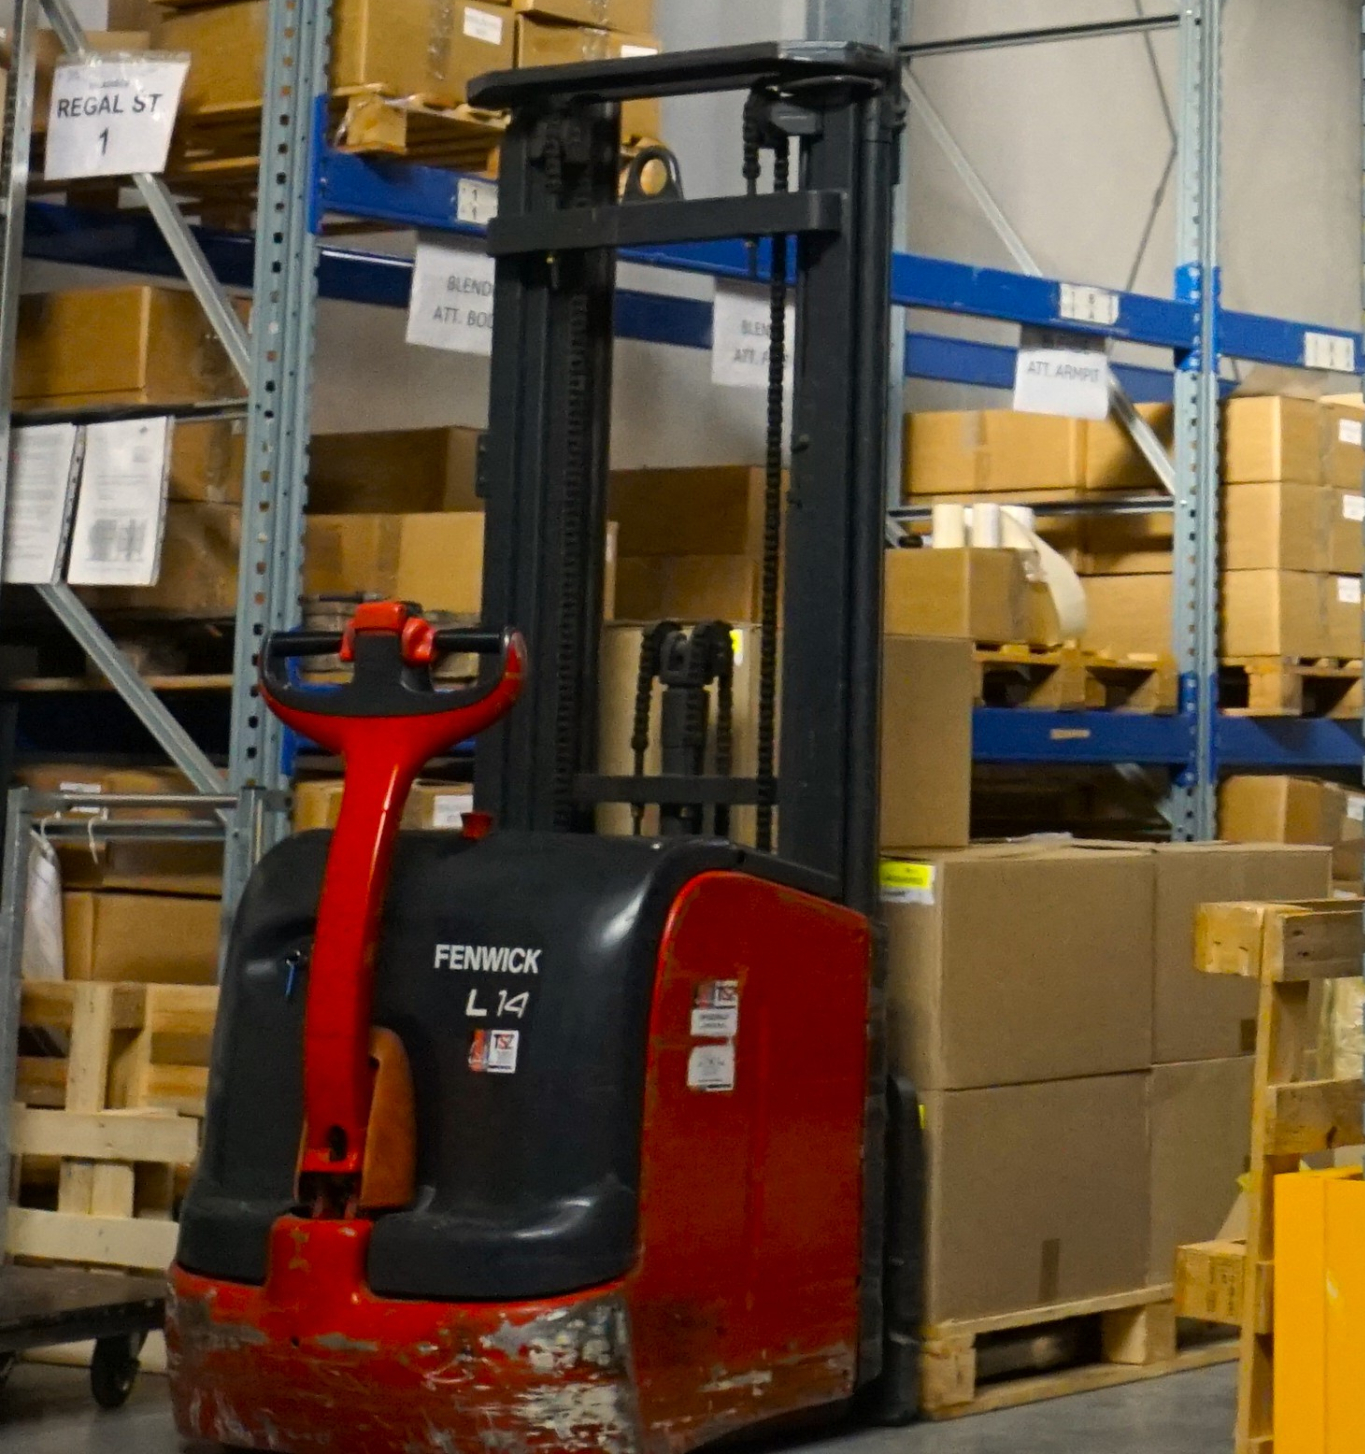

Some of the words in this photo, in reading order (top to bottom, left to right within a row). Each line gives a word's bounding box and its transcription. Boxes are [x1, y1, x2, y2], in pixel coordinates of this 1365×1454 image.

[57, 94, 124, 118] REGAL
[131, 93, 164, 114] ST
[98, 126, 110, 157] 1
[433, 944, 542, 974] FENWICK
[465, 988, 488, 1017] L
[496, 989, 530, 1019] 14
